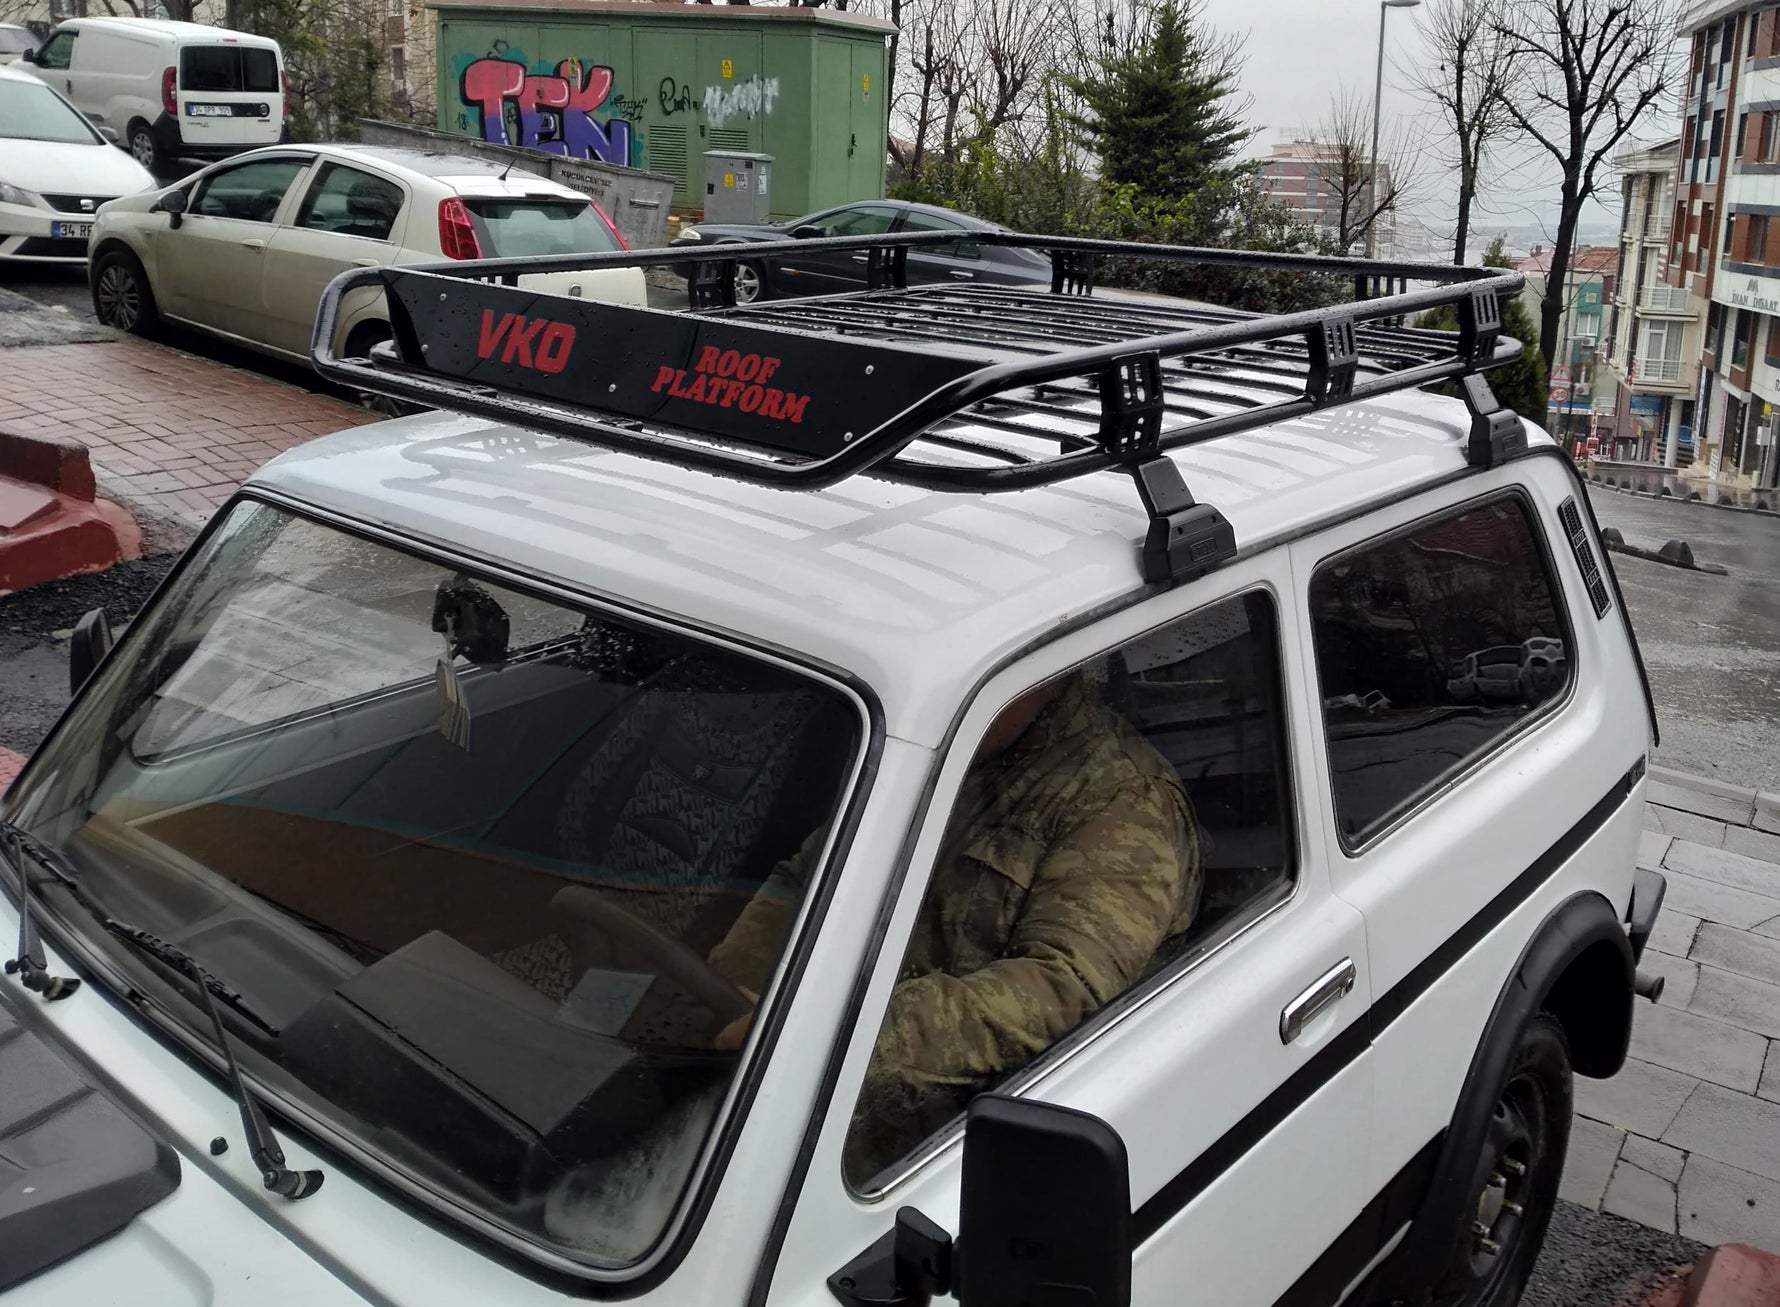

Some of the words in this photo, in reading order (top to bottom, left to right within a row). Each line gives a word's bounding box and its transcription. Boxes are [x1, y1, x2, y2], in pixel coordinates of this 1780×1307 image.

[61, 224, 75, 237] 34
[477, 309, 577, 374] VKO
[695, 345, 781, 386] ROOF
[651, 366, 812, 424] PLATFORM
